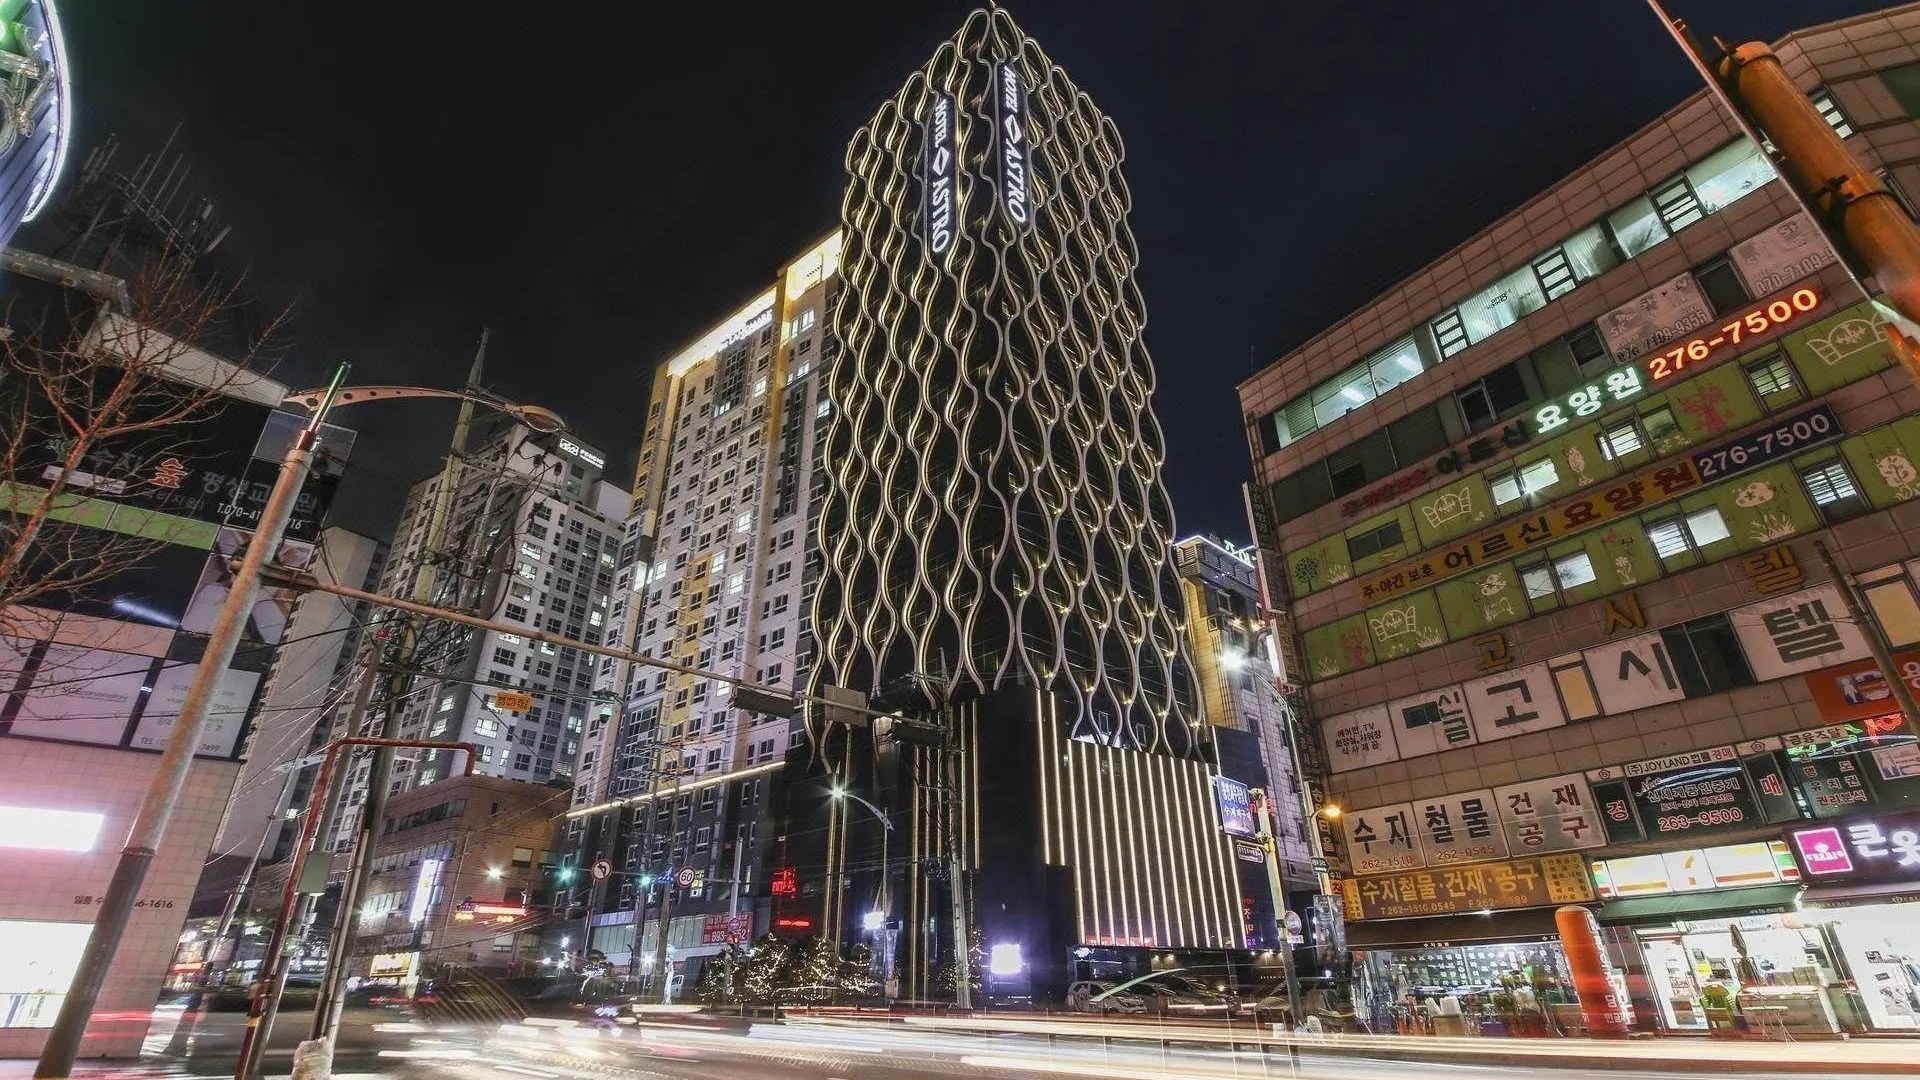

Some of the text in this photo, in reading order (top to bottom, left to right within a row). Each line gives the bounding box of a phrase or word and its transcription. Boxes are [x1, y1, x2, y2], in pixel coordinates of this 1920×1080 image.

[1004, 65, 1026, 223] HOTEL ASTRO
[932, 98, 950, 253] HOTEL ASTRO
[1537, 366, 1643, 434] 요양원
[1649, 287, 1819, 380] 276-7500
[204, 471, 321, 514] 평생교원
[1406, 562, 1435, 581] 보호
[1443, 520, 1552, 570] 어르신
[1562, 465, 1697, 531] 요양원
[1699, 412, 1831, 478] 276-7500
[1712, 747, 1733, 760] 경매
[1508, 783, 1582, 816] 건재
[1647, 777, 1741, 803] 신세계공인중개
[1759, 773, 1783, 796] 매
[1354, 798, 1492, 855] 수지 철물
[1606, 800, 1629, 821] 경
[1657, 807, 1744, 832] 263-9500
[1518, 815, 1589, 847] 공구
[681, 870, 693, 882] 60
[1361, 855, 1413, 870] 262-1510
